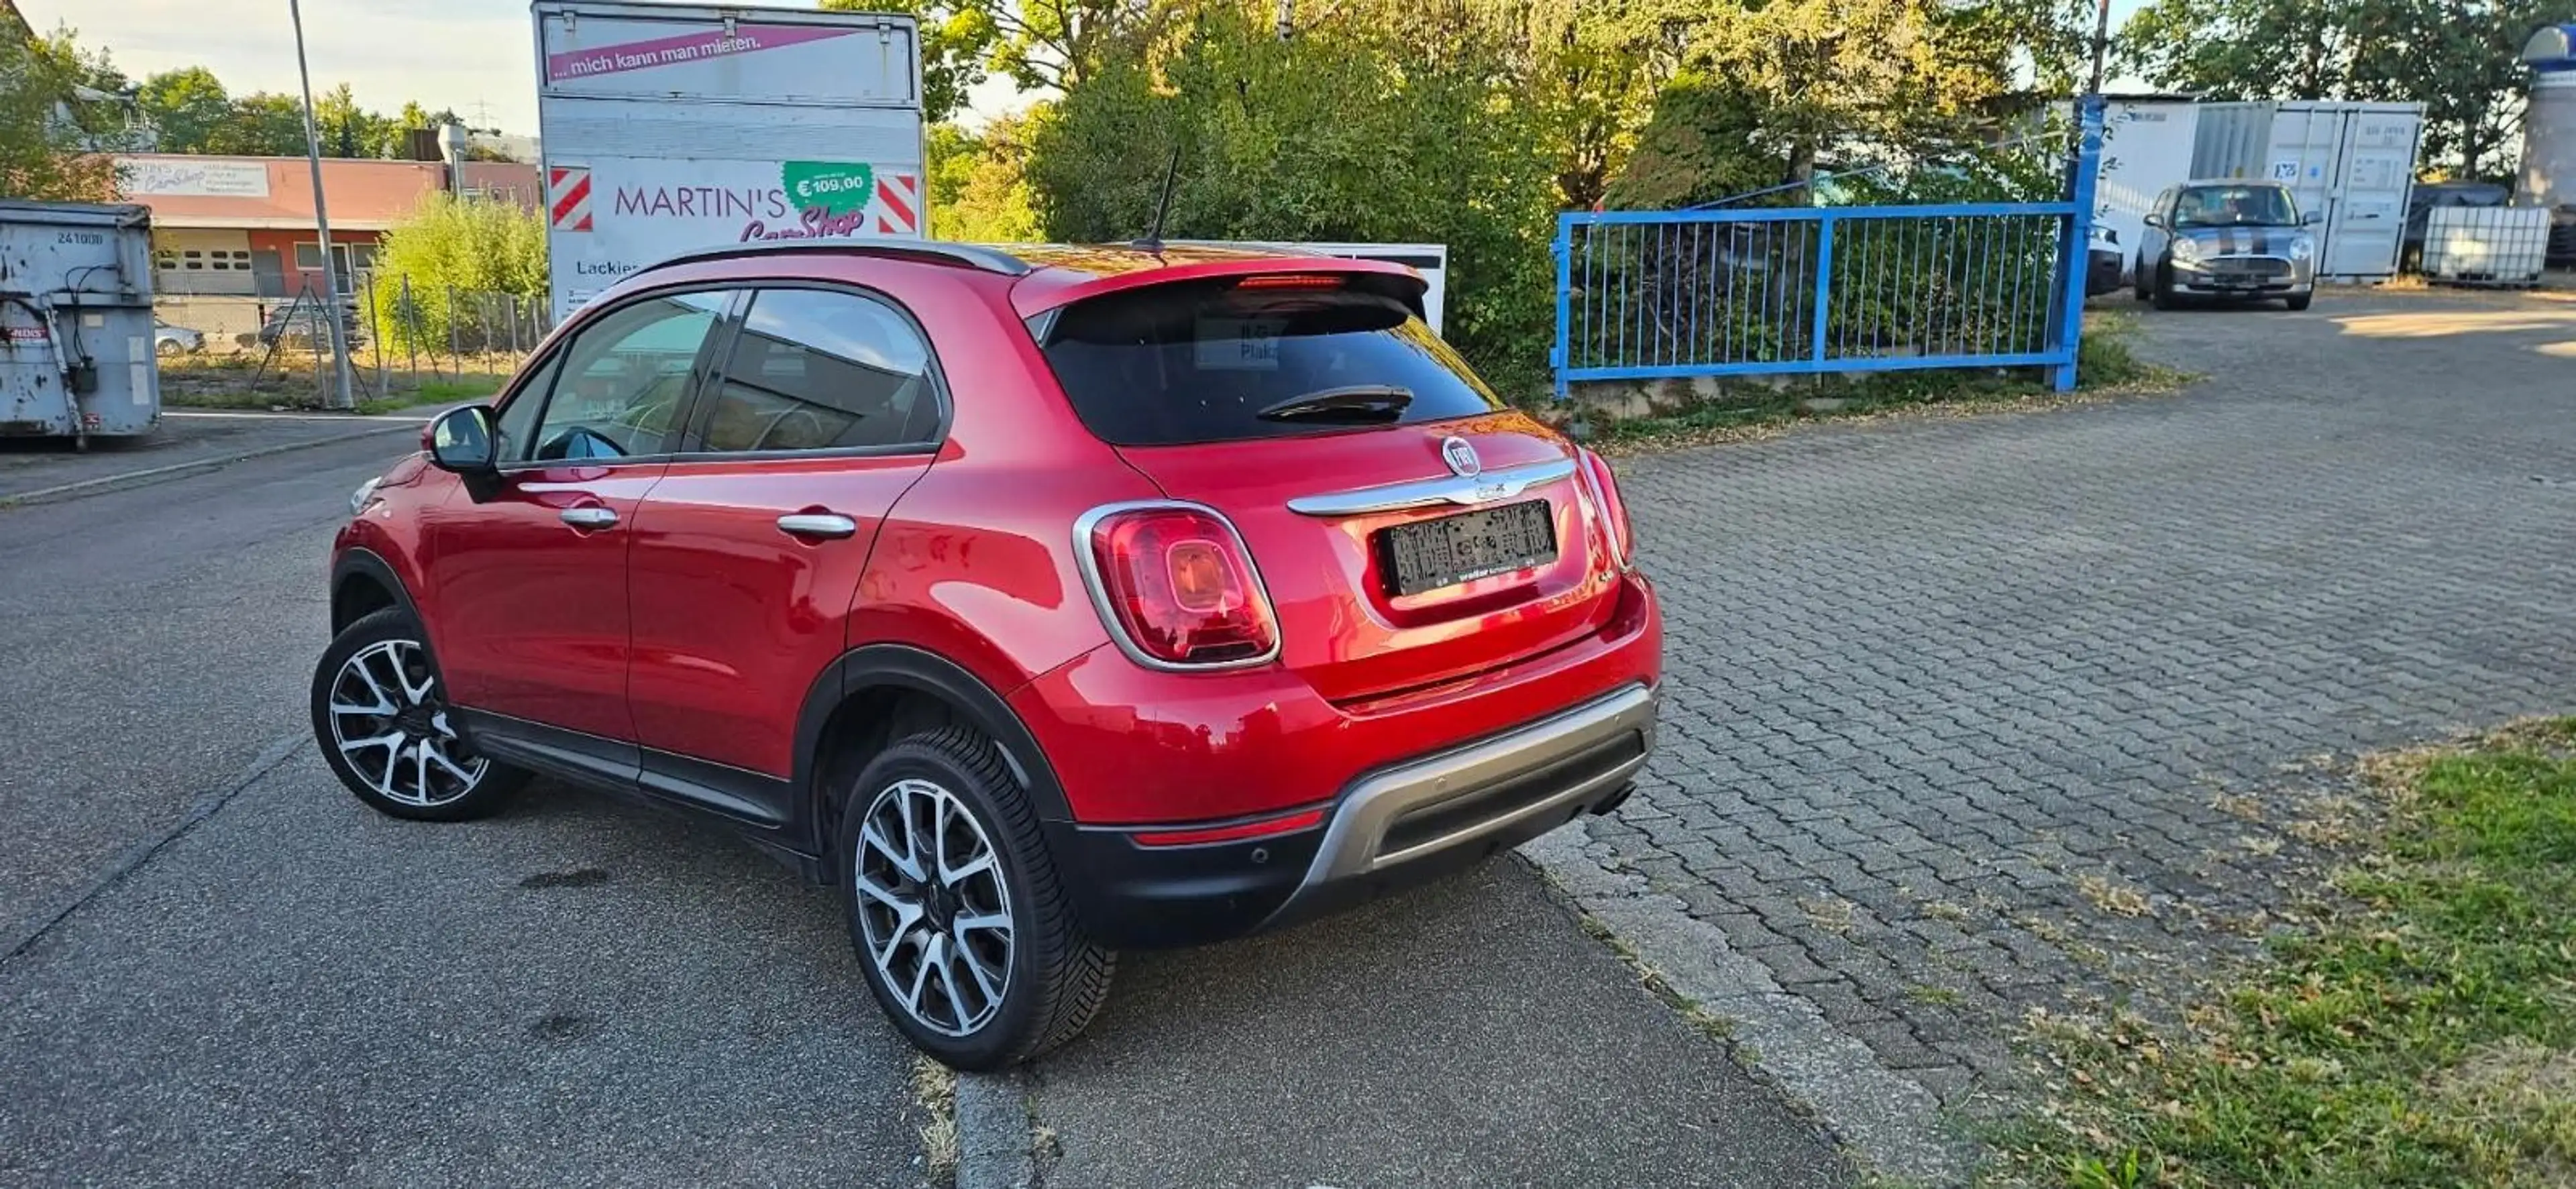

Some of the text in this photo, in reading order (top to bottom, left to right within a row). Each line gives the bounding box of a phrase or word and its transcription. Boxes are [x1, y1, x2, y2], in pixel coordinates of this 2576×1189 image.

[571, 58, 612, 75] mich
[616, 53, 657, 68] kann
[661, 45, 698, 62] man
[701, 36, 761, 56] mieten.
[614, 186, 786, 218] MARTIN'S
